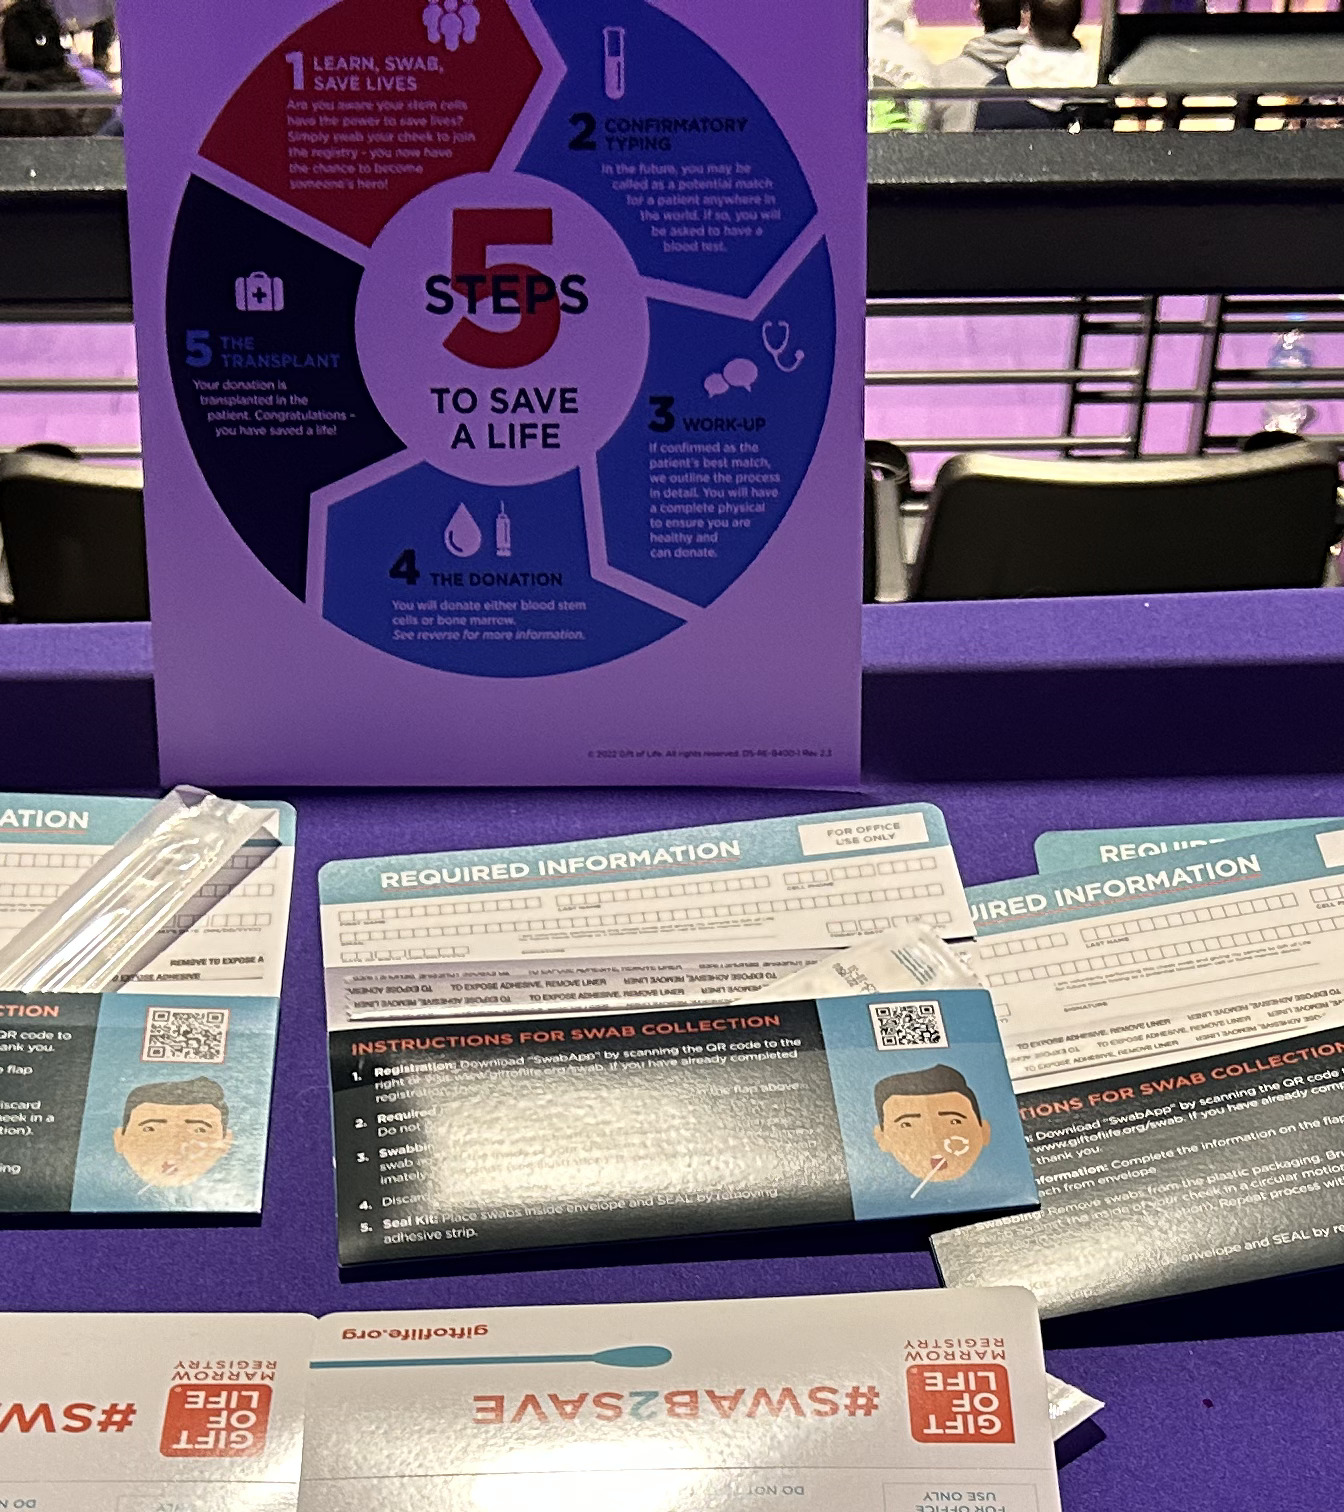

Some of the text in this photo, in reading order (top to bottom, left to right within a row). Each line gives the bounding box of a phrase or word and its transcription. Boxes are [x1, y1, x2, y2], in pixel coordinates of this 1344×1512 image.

[286, 51, 304, 90] 1
[313, 56, 443, 74] LEARN, SWAB,
[314, 76, 417, 91] SAVE LIVES
[568, 112, 596, 150] 2
[605, 118, 748, 133] CONFIRMATORY
[606, 137, 671, 151] TYPING
[425, 274, 588, 314] STEPS
[443, 209, 560, 369] 5
[186, 330, 212, 367] 5
[220, 337, 255, 349] THE
[222, 353, 340, 368] TRANSPLANT
[193, 379, 274, 390] Your donation
[430, 387, 579, 414] TO SAVE
[255, 410, 346, 422] Congratulations
[648, 396, 674, 432] 3
[683, 417, 766, 431] WORK-UP
[451, 423, 560, 449] A LIFE
[389, 549, 420, 585] 4
[430, 572, 562, 586] THE DONATION
[440, 601, 481, 610] donate
[521, 601, 555, 610] blood
[437, 615, 466, 625] bone
[380, 840, 741, 889] REQUIRED INFORMATION
[1054, 854, 1261, 906] INFORMATION
[352, 1015, 781, 1055] INSTRUCTIONS FOR SWAB COLLECTION
[1088, 1086, 1135, 1107] FOR
[1140, 1072, 1206, 1096] SWAB
[1036, 1070, 1338, 1140] Download scanning code
[1110, 1129, 1276, 1169] Complete information
[1272, 1230, 1310, 1246] SEAL
[341, 1324, 489, 1342] giftoflife.org
[904, 1338, 1004, 1349] REGISTRY
[905, 1350, 1005, 1361] MARROW
[174, 1361, 277, 1369] REGISTRY
[171, 1371, 275, 1381] MARROW
[924, 1371, 997, 1391] LIFE
[185, 1391, 259, 1408] LIFE
[474, 1384, 880, 1424] #SWAB2SAVE
[952, 1393, 999, 1412] OF
[207, 1410, 256, 1428] OF
[923, 1414, 1001, 1434] GIFT
[172, 1430, 254, 1449] GIFT
[924, 1492, 996, 1502] USE ONLY
